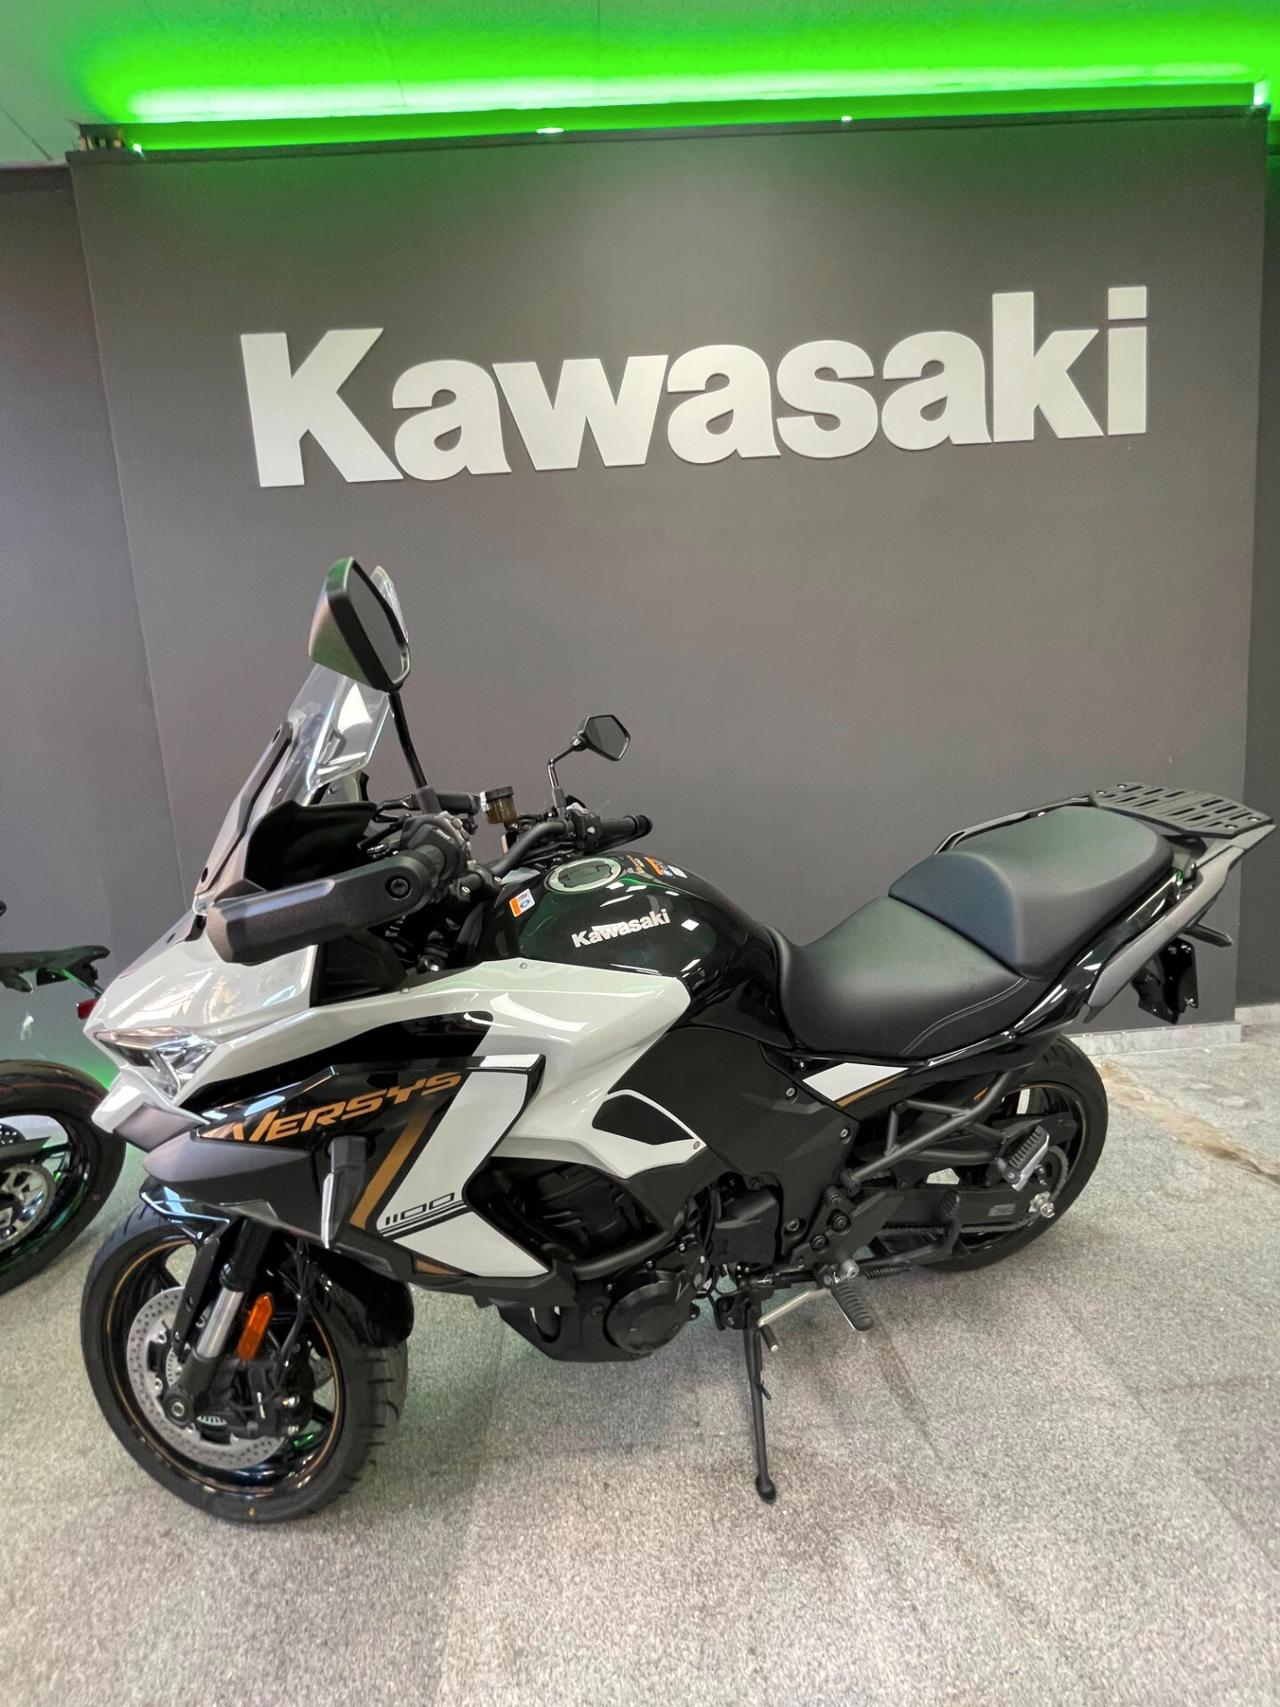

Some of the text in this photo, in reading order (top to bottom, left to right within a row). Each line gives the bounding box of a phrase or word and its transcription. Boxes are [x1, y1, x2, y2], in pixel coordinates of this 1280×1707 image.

[240, 285, 1148, 487] Kawasaki
[571, 909, 670, 948] Kawasaki
[202, 1072, 462, 1142] VERSYS
[385, 1192, 455, 1225] 1100
